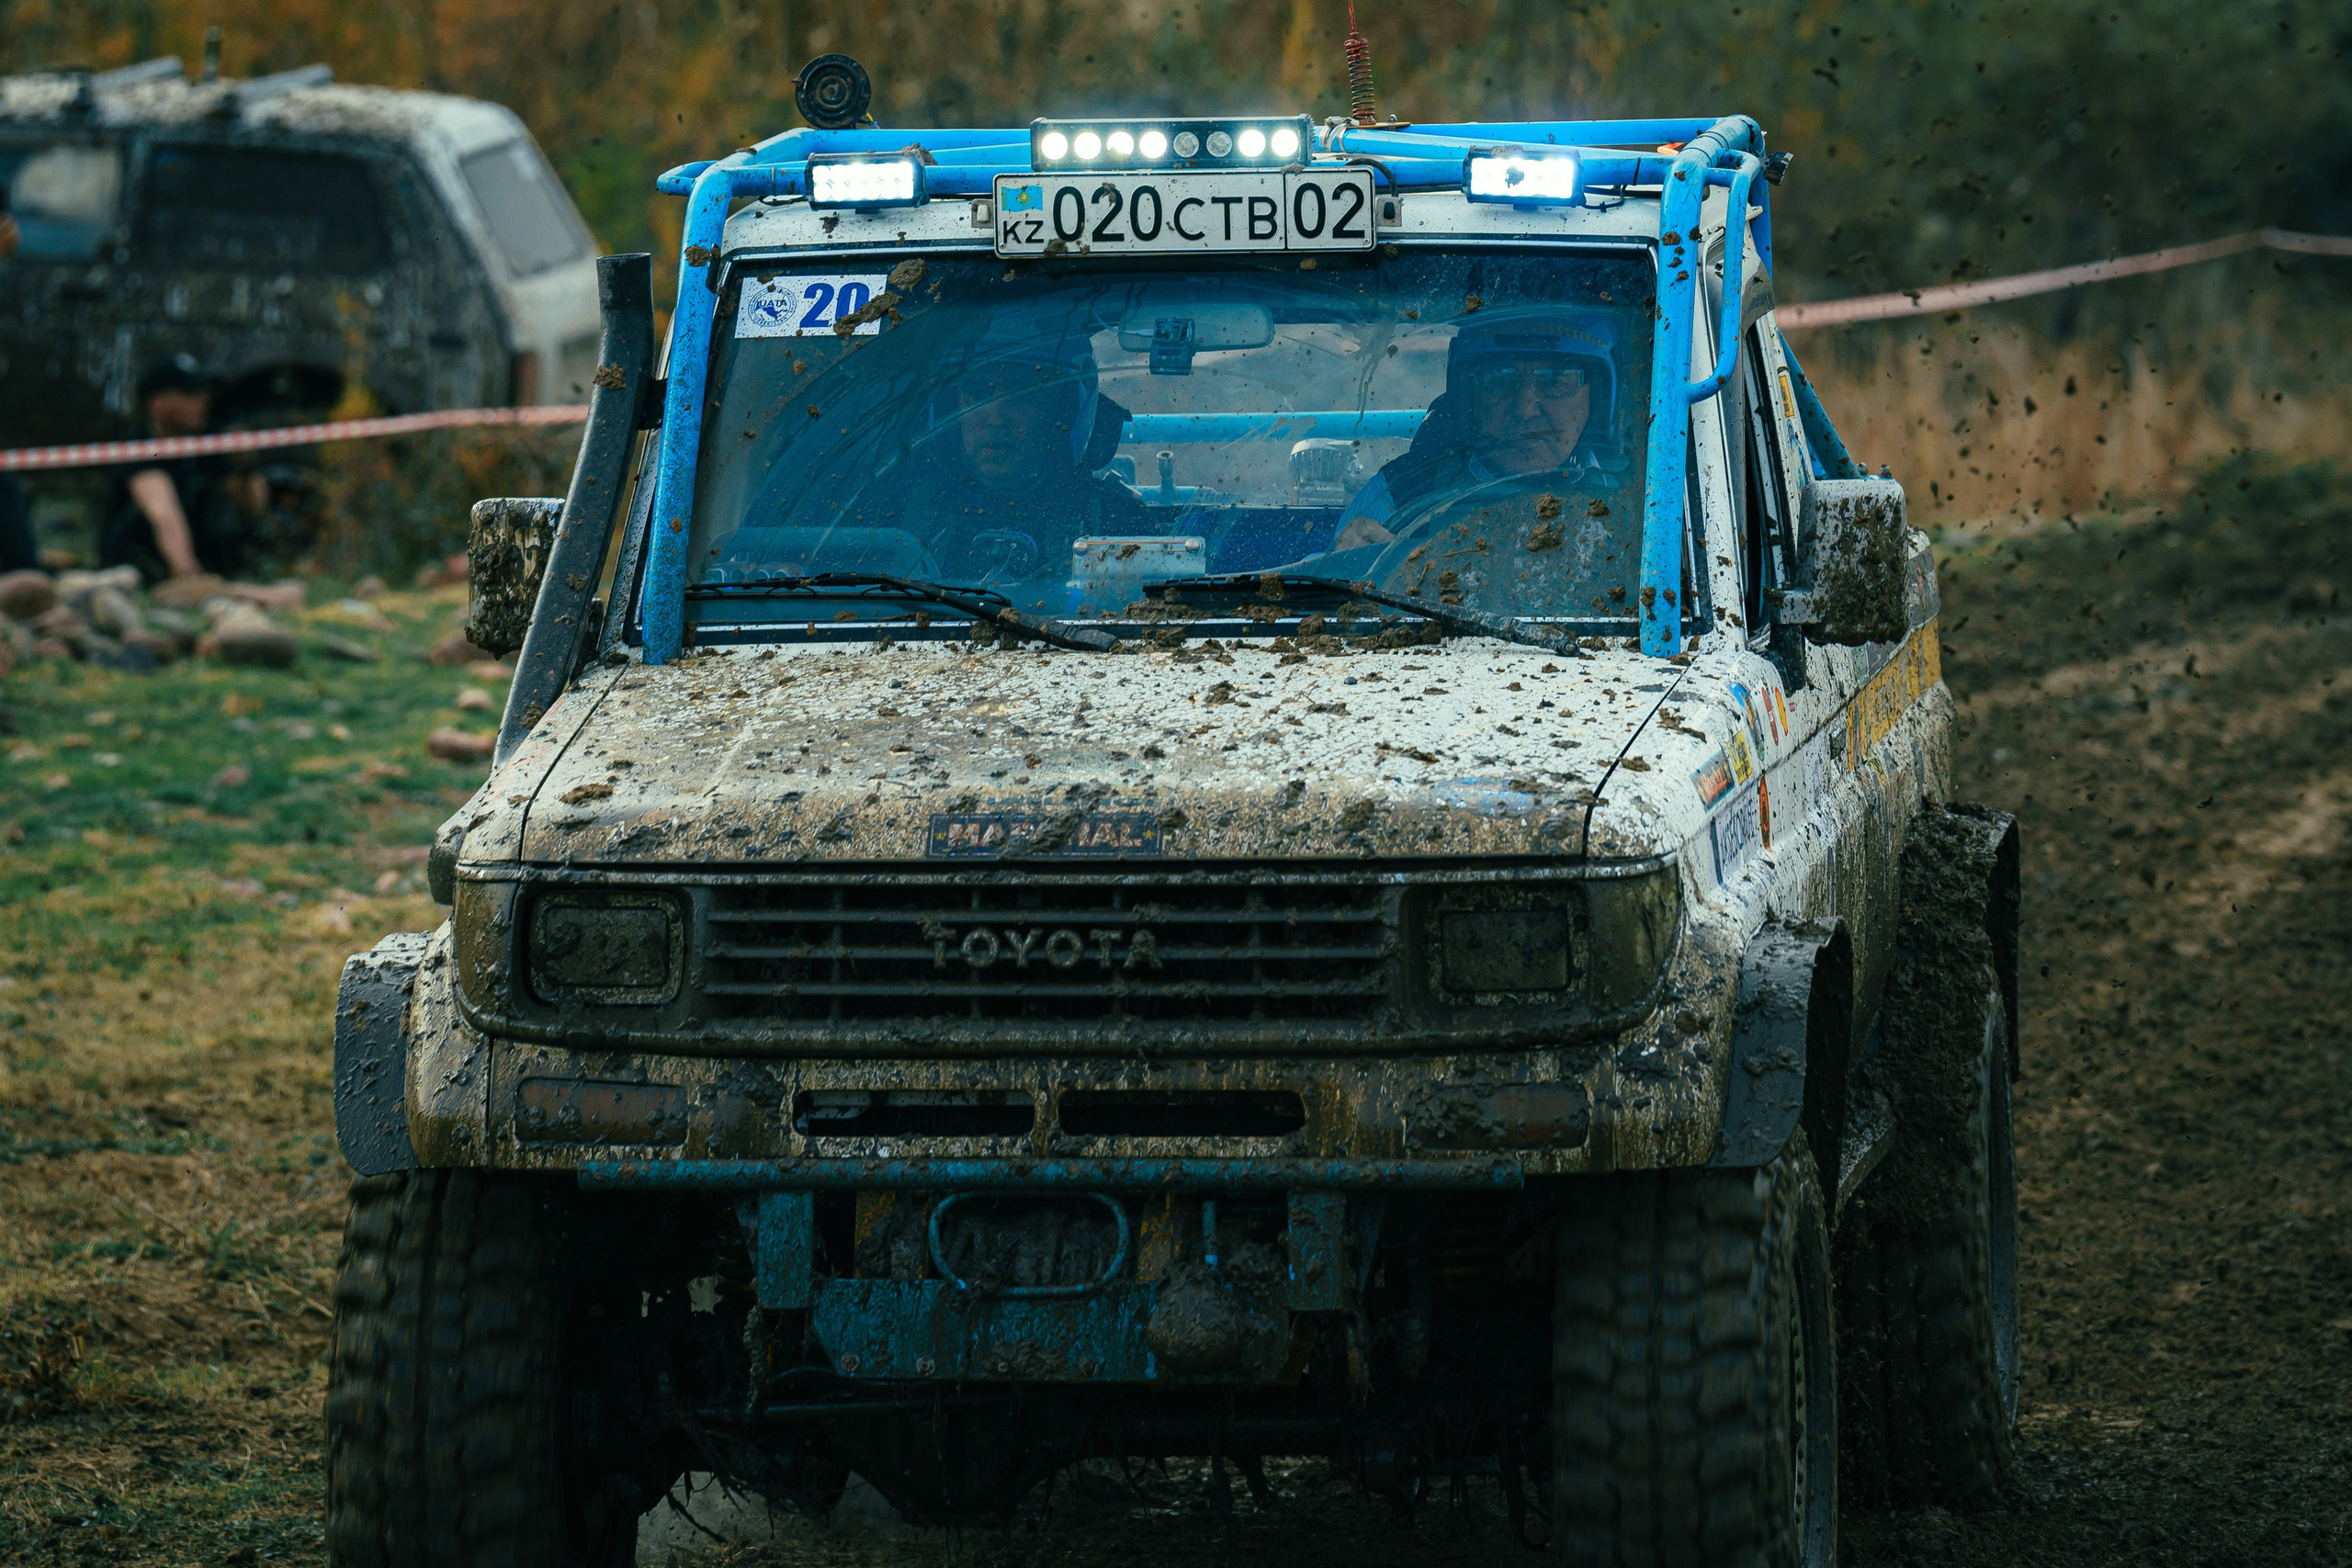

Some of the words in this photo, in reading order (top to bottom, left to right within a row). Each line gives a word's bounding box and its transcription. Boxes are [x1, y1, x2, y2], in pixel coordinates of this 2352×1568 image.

[1002, 220, 1044, 244] KZ
[1293, 182, 1365, 239] 02
[759, 299, 787, 308] UATA
[799, 282, 870, 328] 20
[924, 928, 1163, 968] TOYOTA
